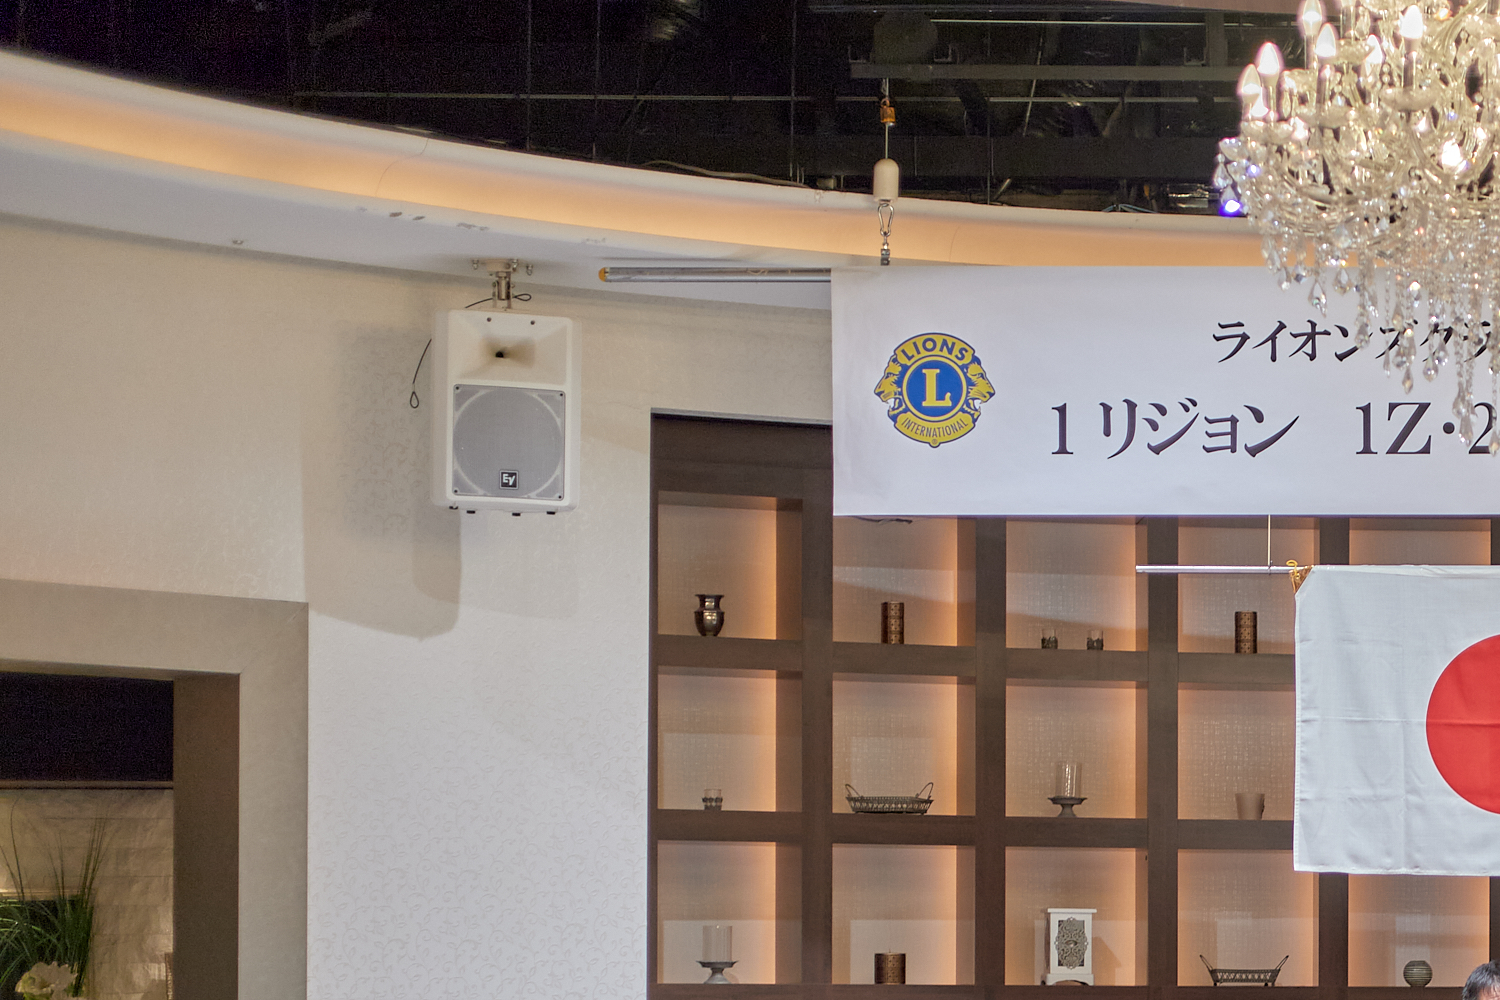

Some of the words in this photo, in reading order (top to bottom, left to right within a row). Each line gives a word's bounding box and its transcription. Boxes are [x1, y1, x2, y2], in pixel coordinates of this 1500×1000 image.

[900, 337, 969, 361] LIONS
[922, 368, 952, 407] L
[901, 417, 969, 439] INTERNATIONAL
